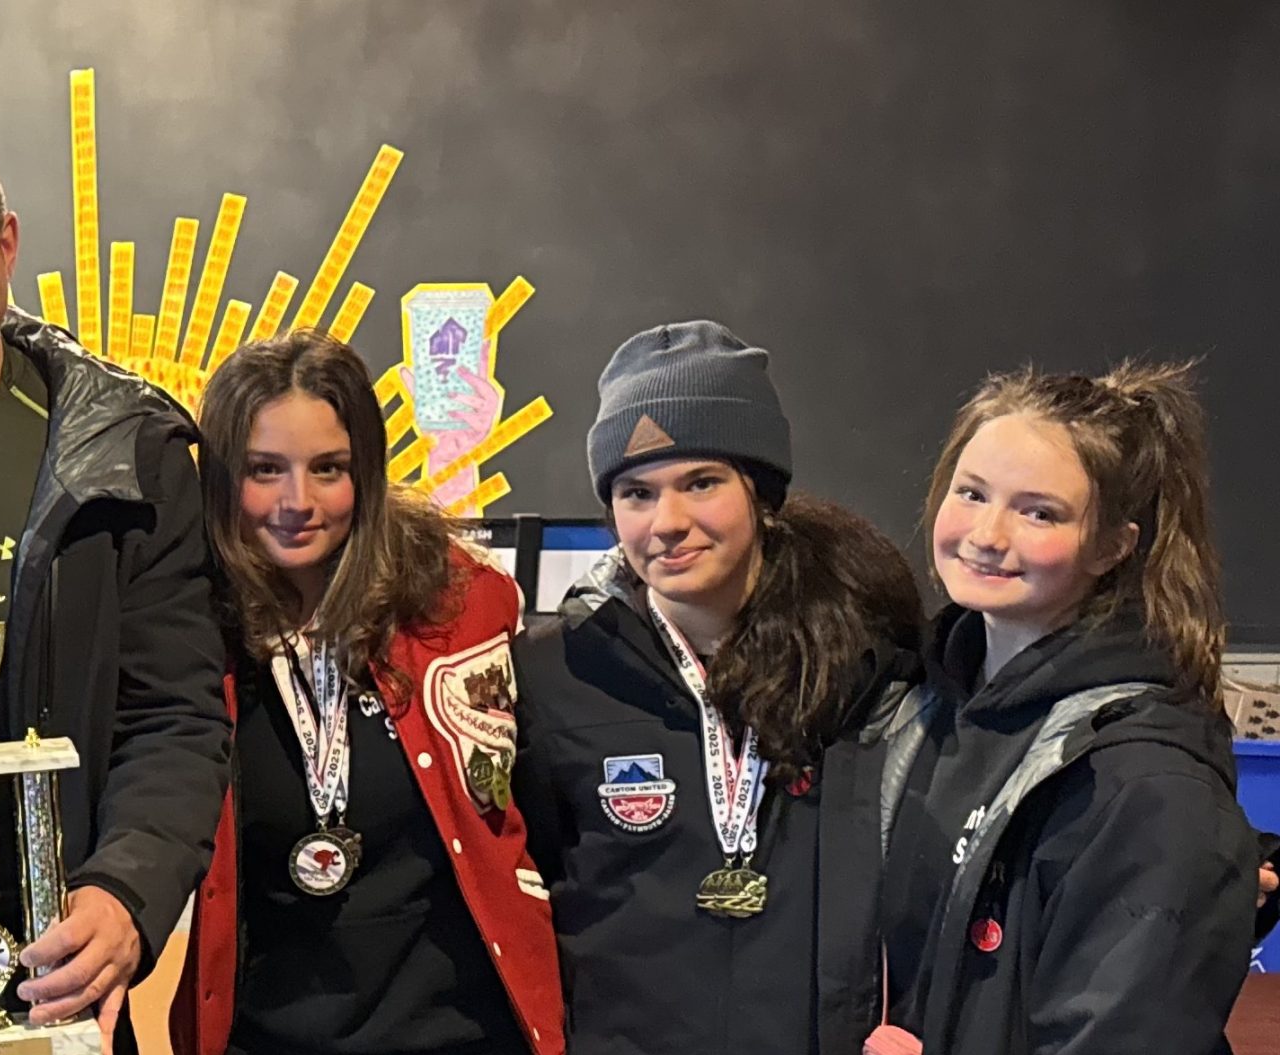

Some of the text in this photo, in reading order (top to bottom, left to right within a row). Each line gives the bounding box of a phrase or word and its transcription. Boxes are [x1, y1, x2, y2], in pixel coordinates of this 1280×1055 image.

[671, 642, 692, 669] 2025
[707, 725, 720, 757] 2025
[747, 737, 759, 760] 202
[327, 748, 341, 778] 2025
[712, 775, 725, 805] 2025
[736, 779, 751, 809] 2025
